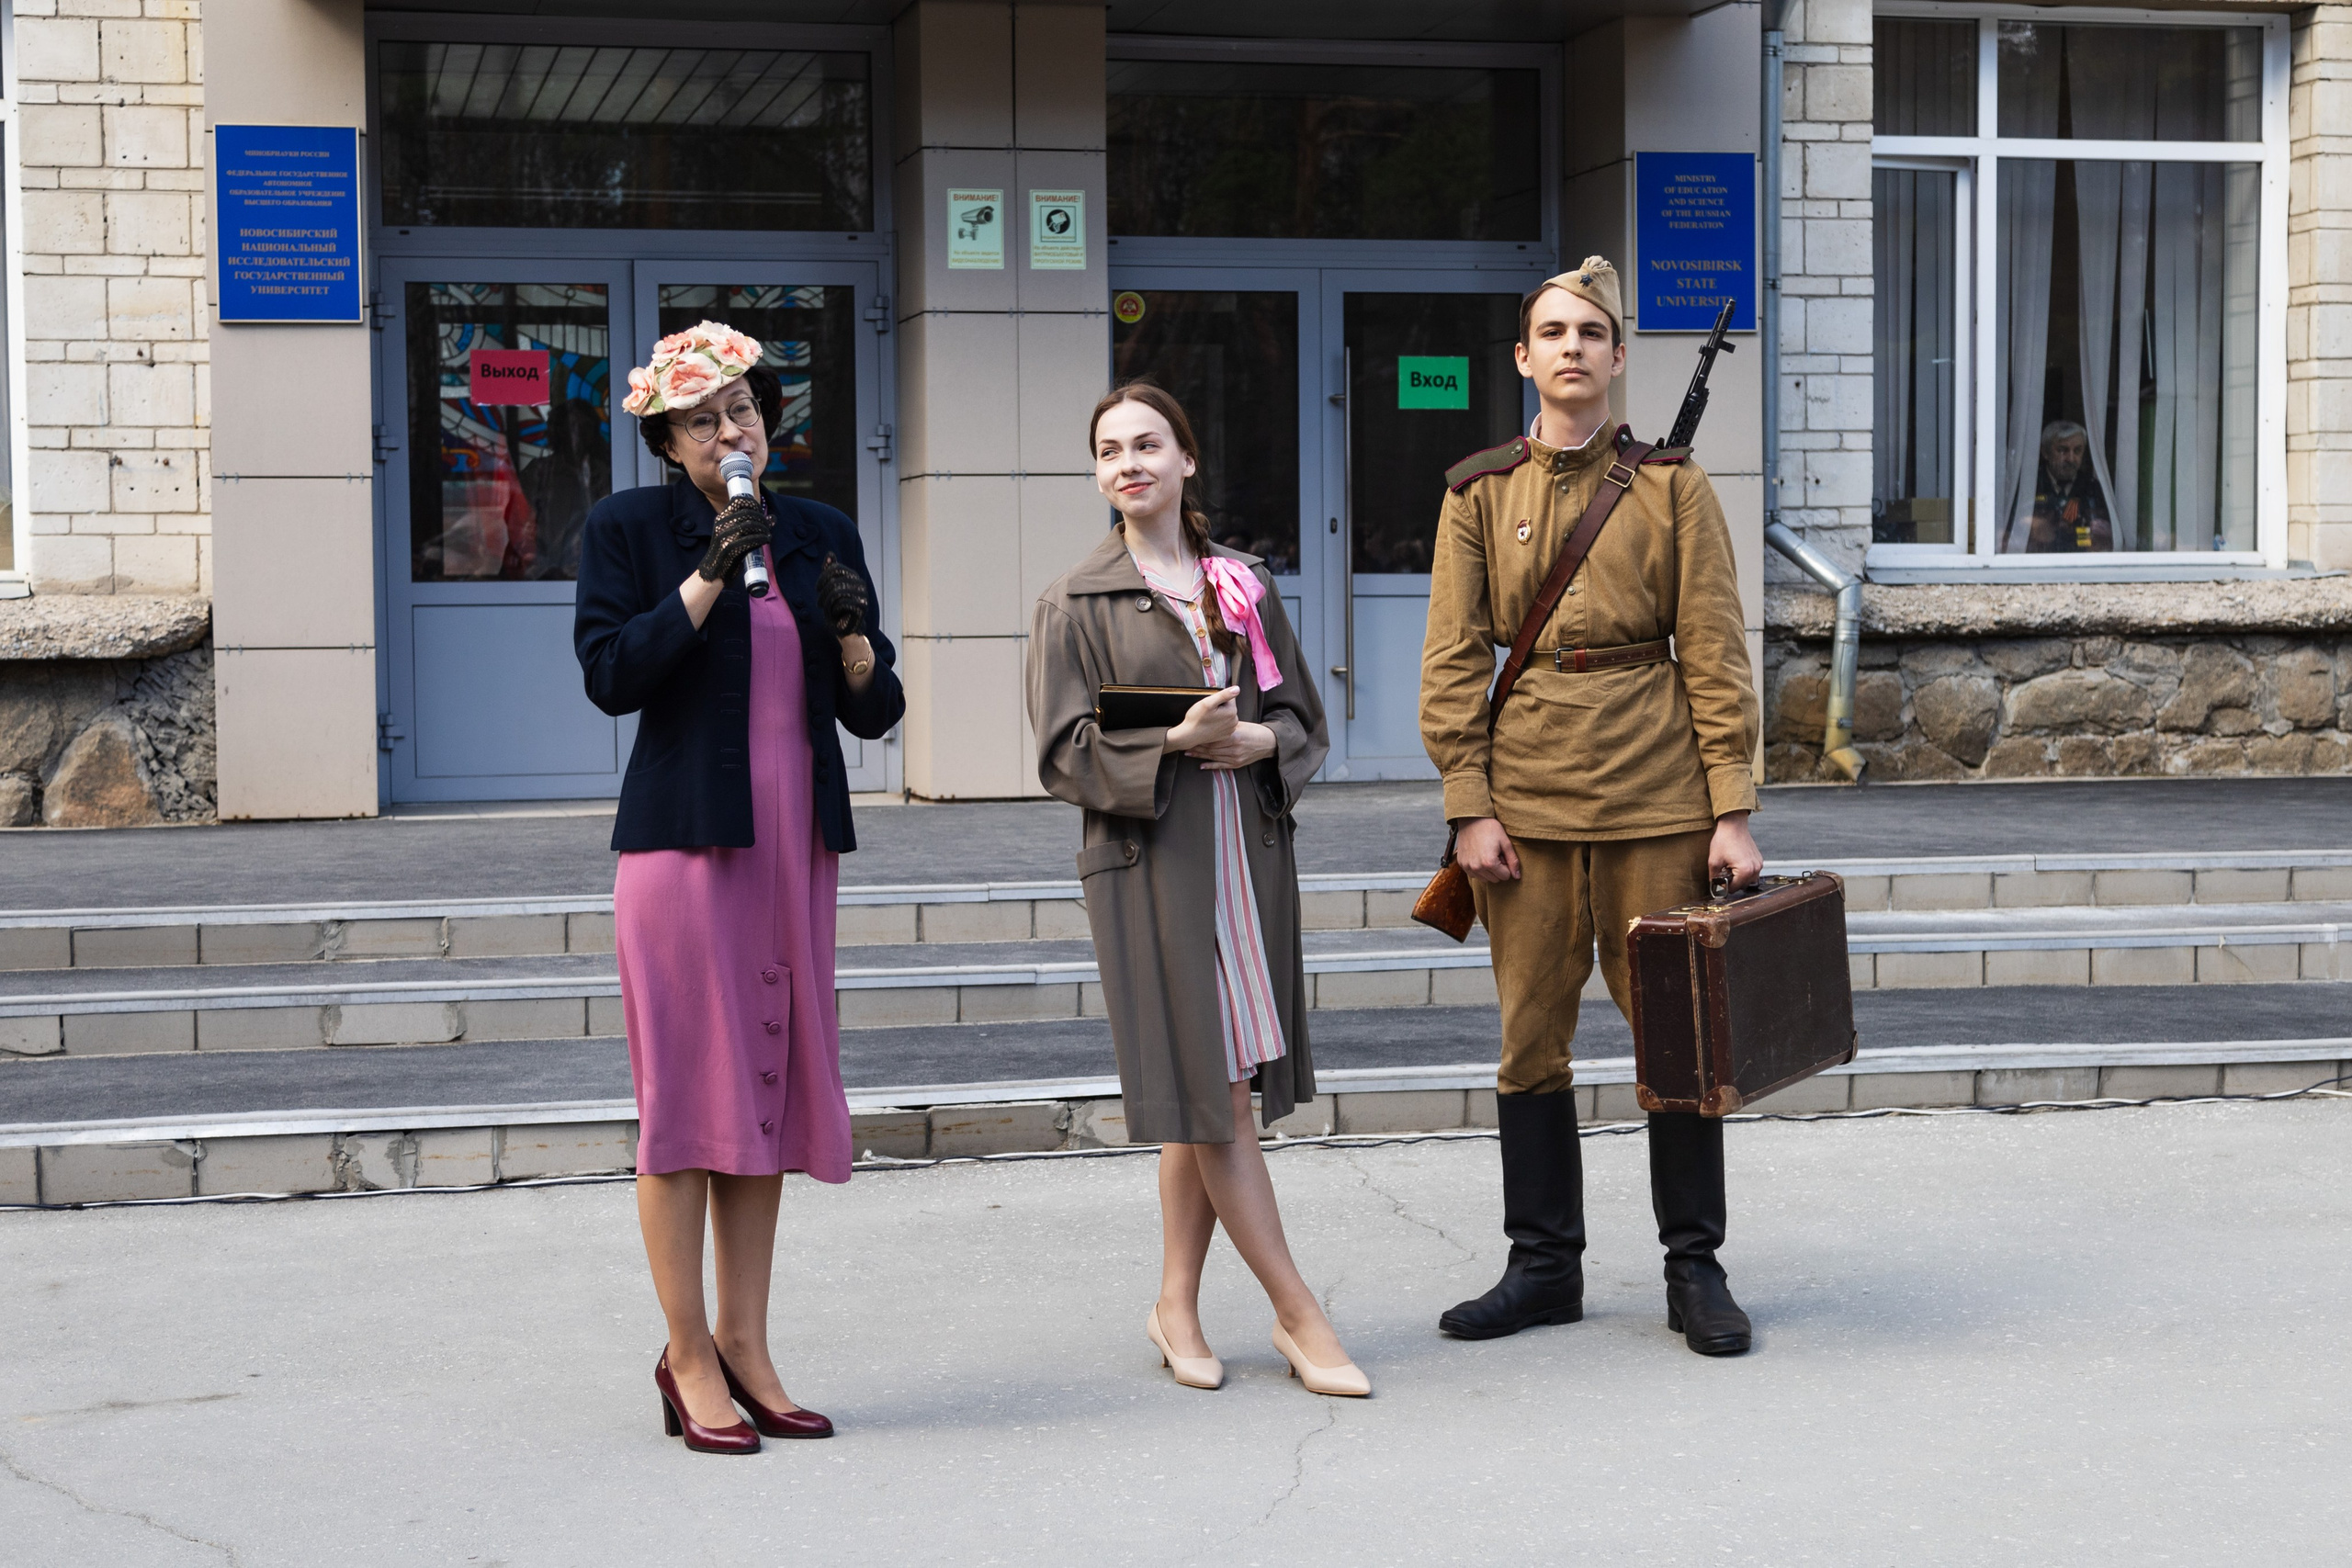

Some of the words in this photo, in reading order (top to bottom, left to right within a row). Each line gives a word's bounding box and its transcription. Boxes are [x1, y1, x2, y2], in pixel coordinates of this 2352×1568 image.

[240, 229, 337, 238] НОВОСИБИРСКИЙ
[242, 243, 336, 253] НАЦИОНАЛЬНЫЙ
[228, 257, 350, 266] ИССЛЕДОВАТЕЛЬСКИЙ
[1651, 260, 1742, 271] NOVOSIBIRSK
[234, 271, 345, 280] ГОСУДАРСТВЕННЫЙ
[1677, 278, 1716, 288] STATE
[251, 286, 329, 294] УНИВЕРСИТЕТ
[481, 364, 538, 381] Выход
[1411, 371, 1457, 390] Вход
